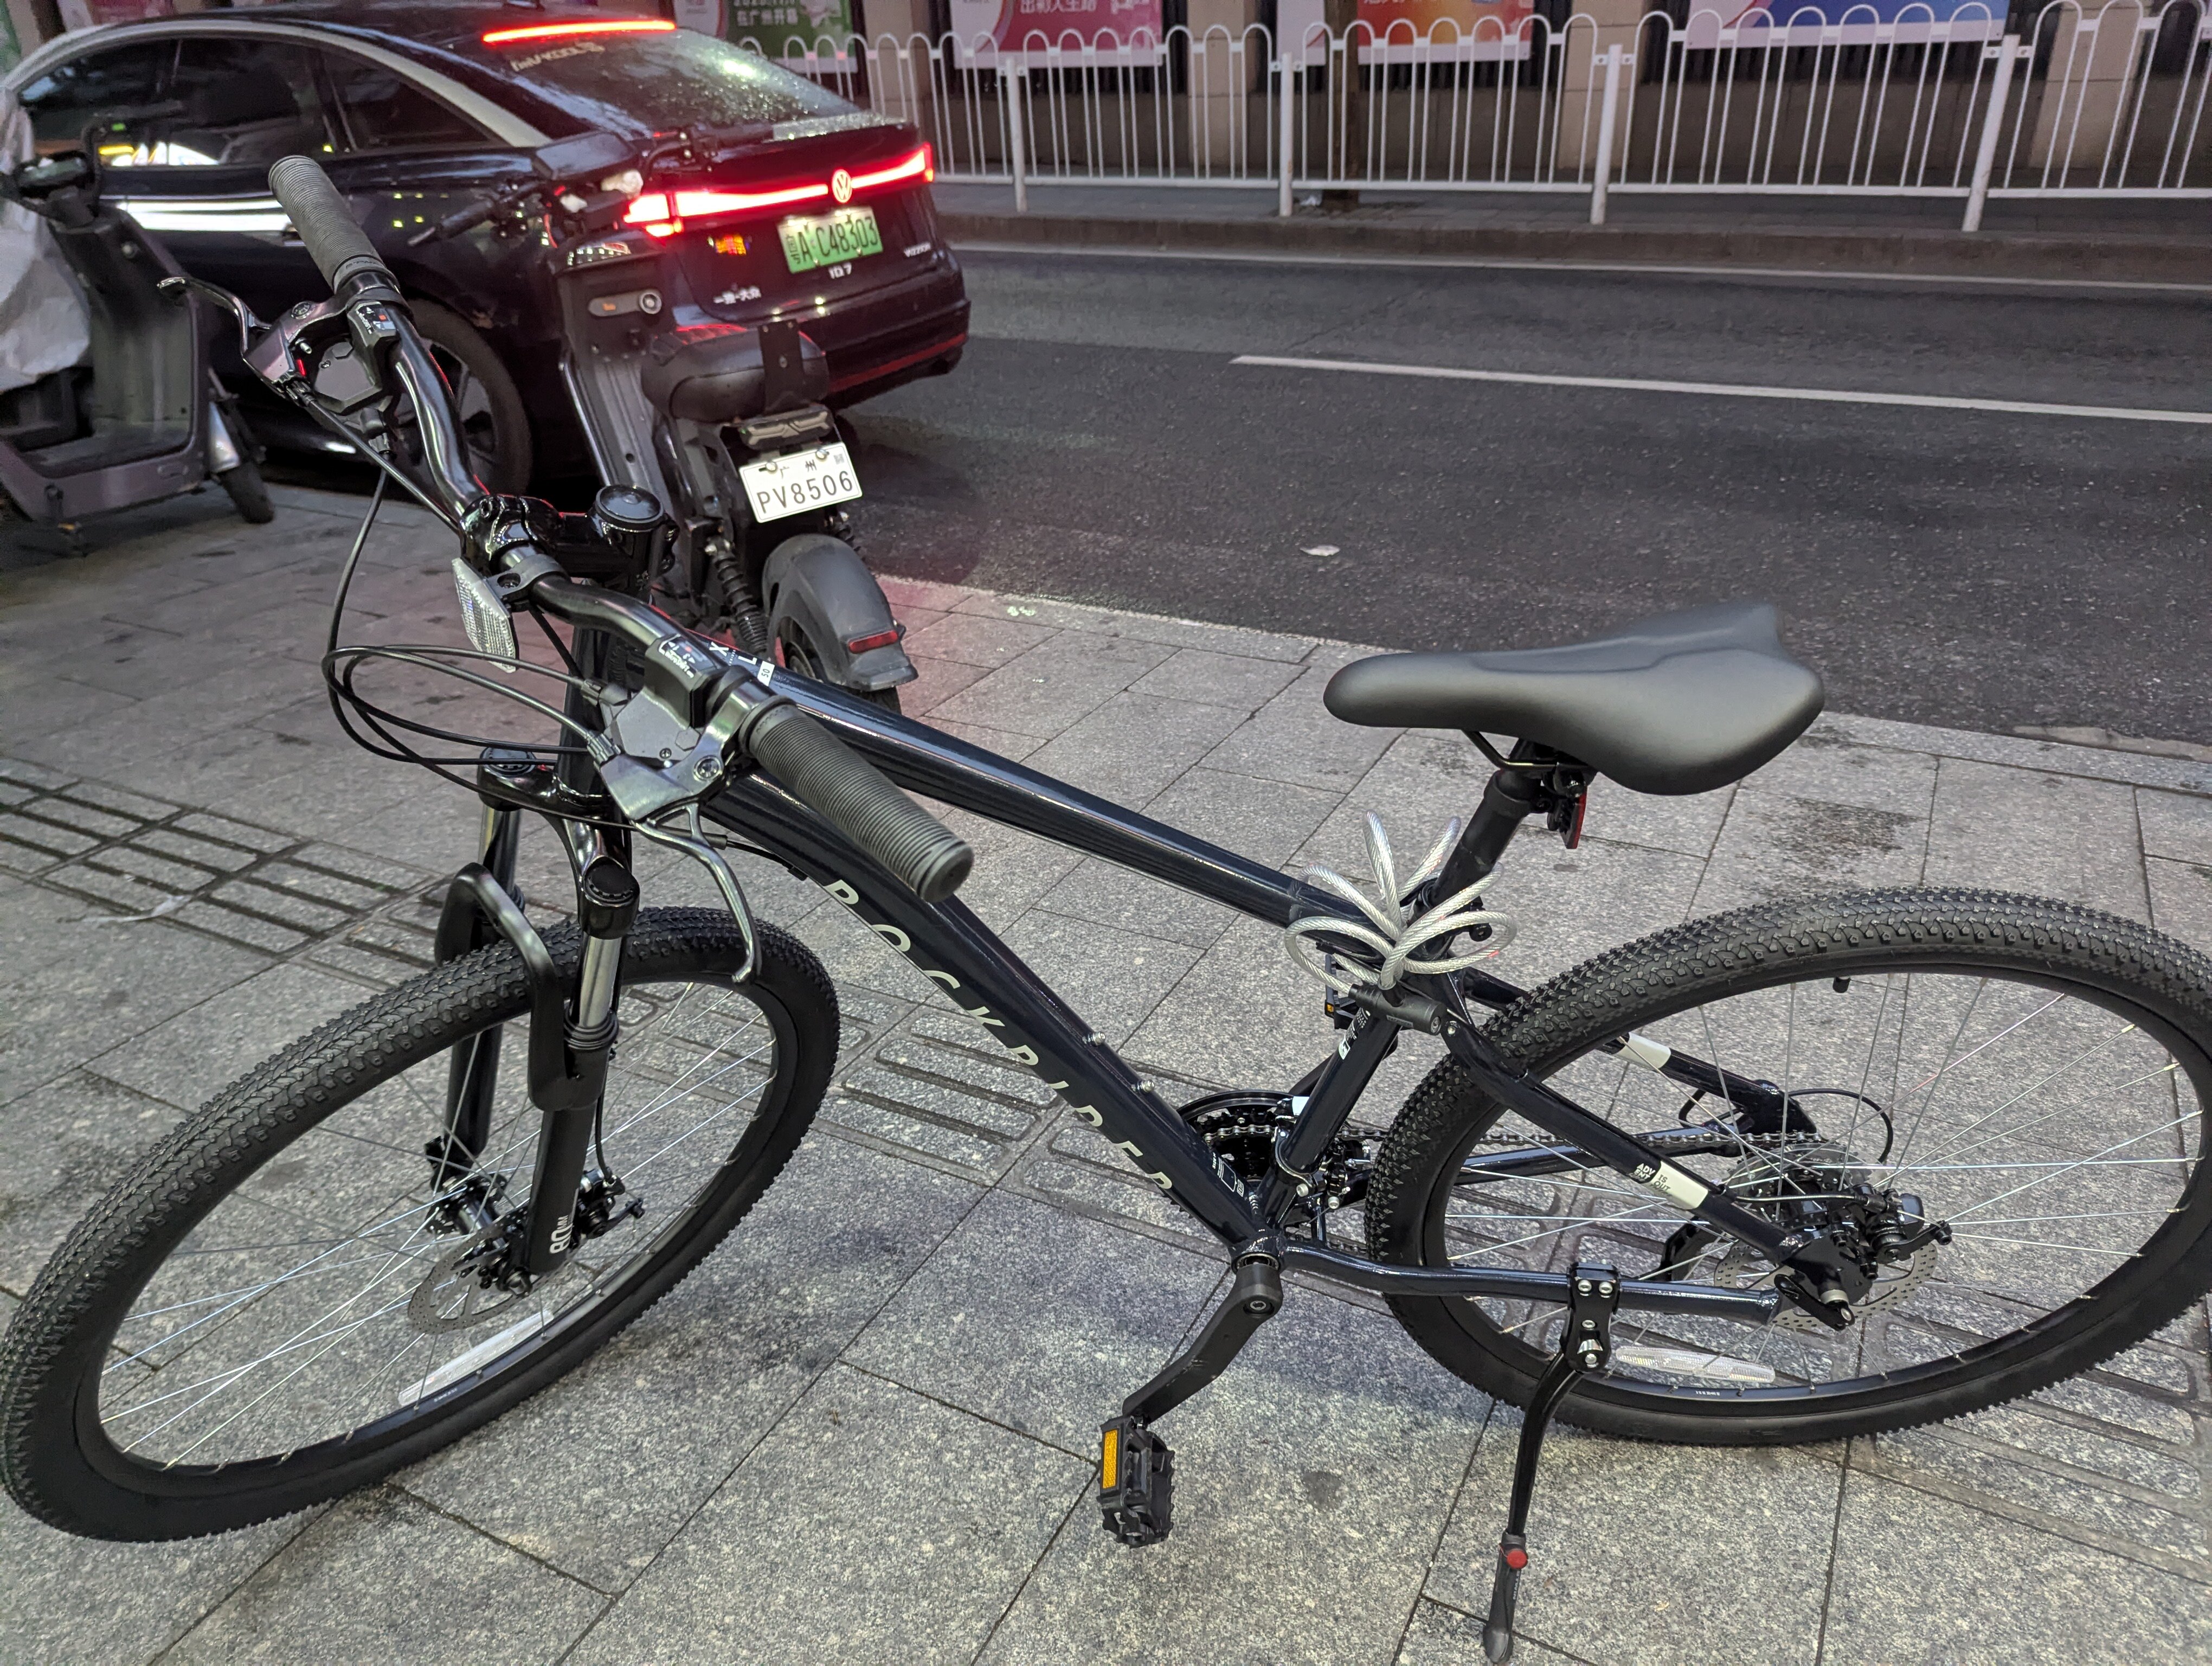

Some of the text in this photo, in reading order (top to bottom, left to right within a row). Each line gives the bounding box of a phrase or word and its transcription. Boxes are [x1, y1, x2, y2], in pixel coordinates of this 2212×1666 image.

[816, 214, 878, 257] C48303
[756, 471, 853, 514] PV8506
[761, 668, 770, 678] 50
